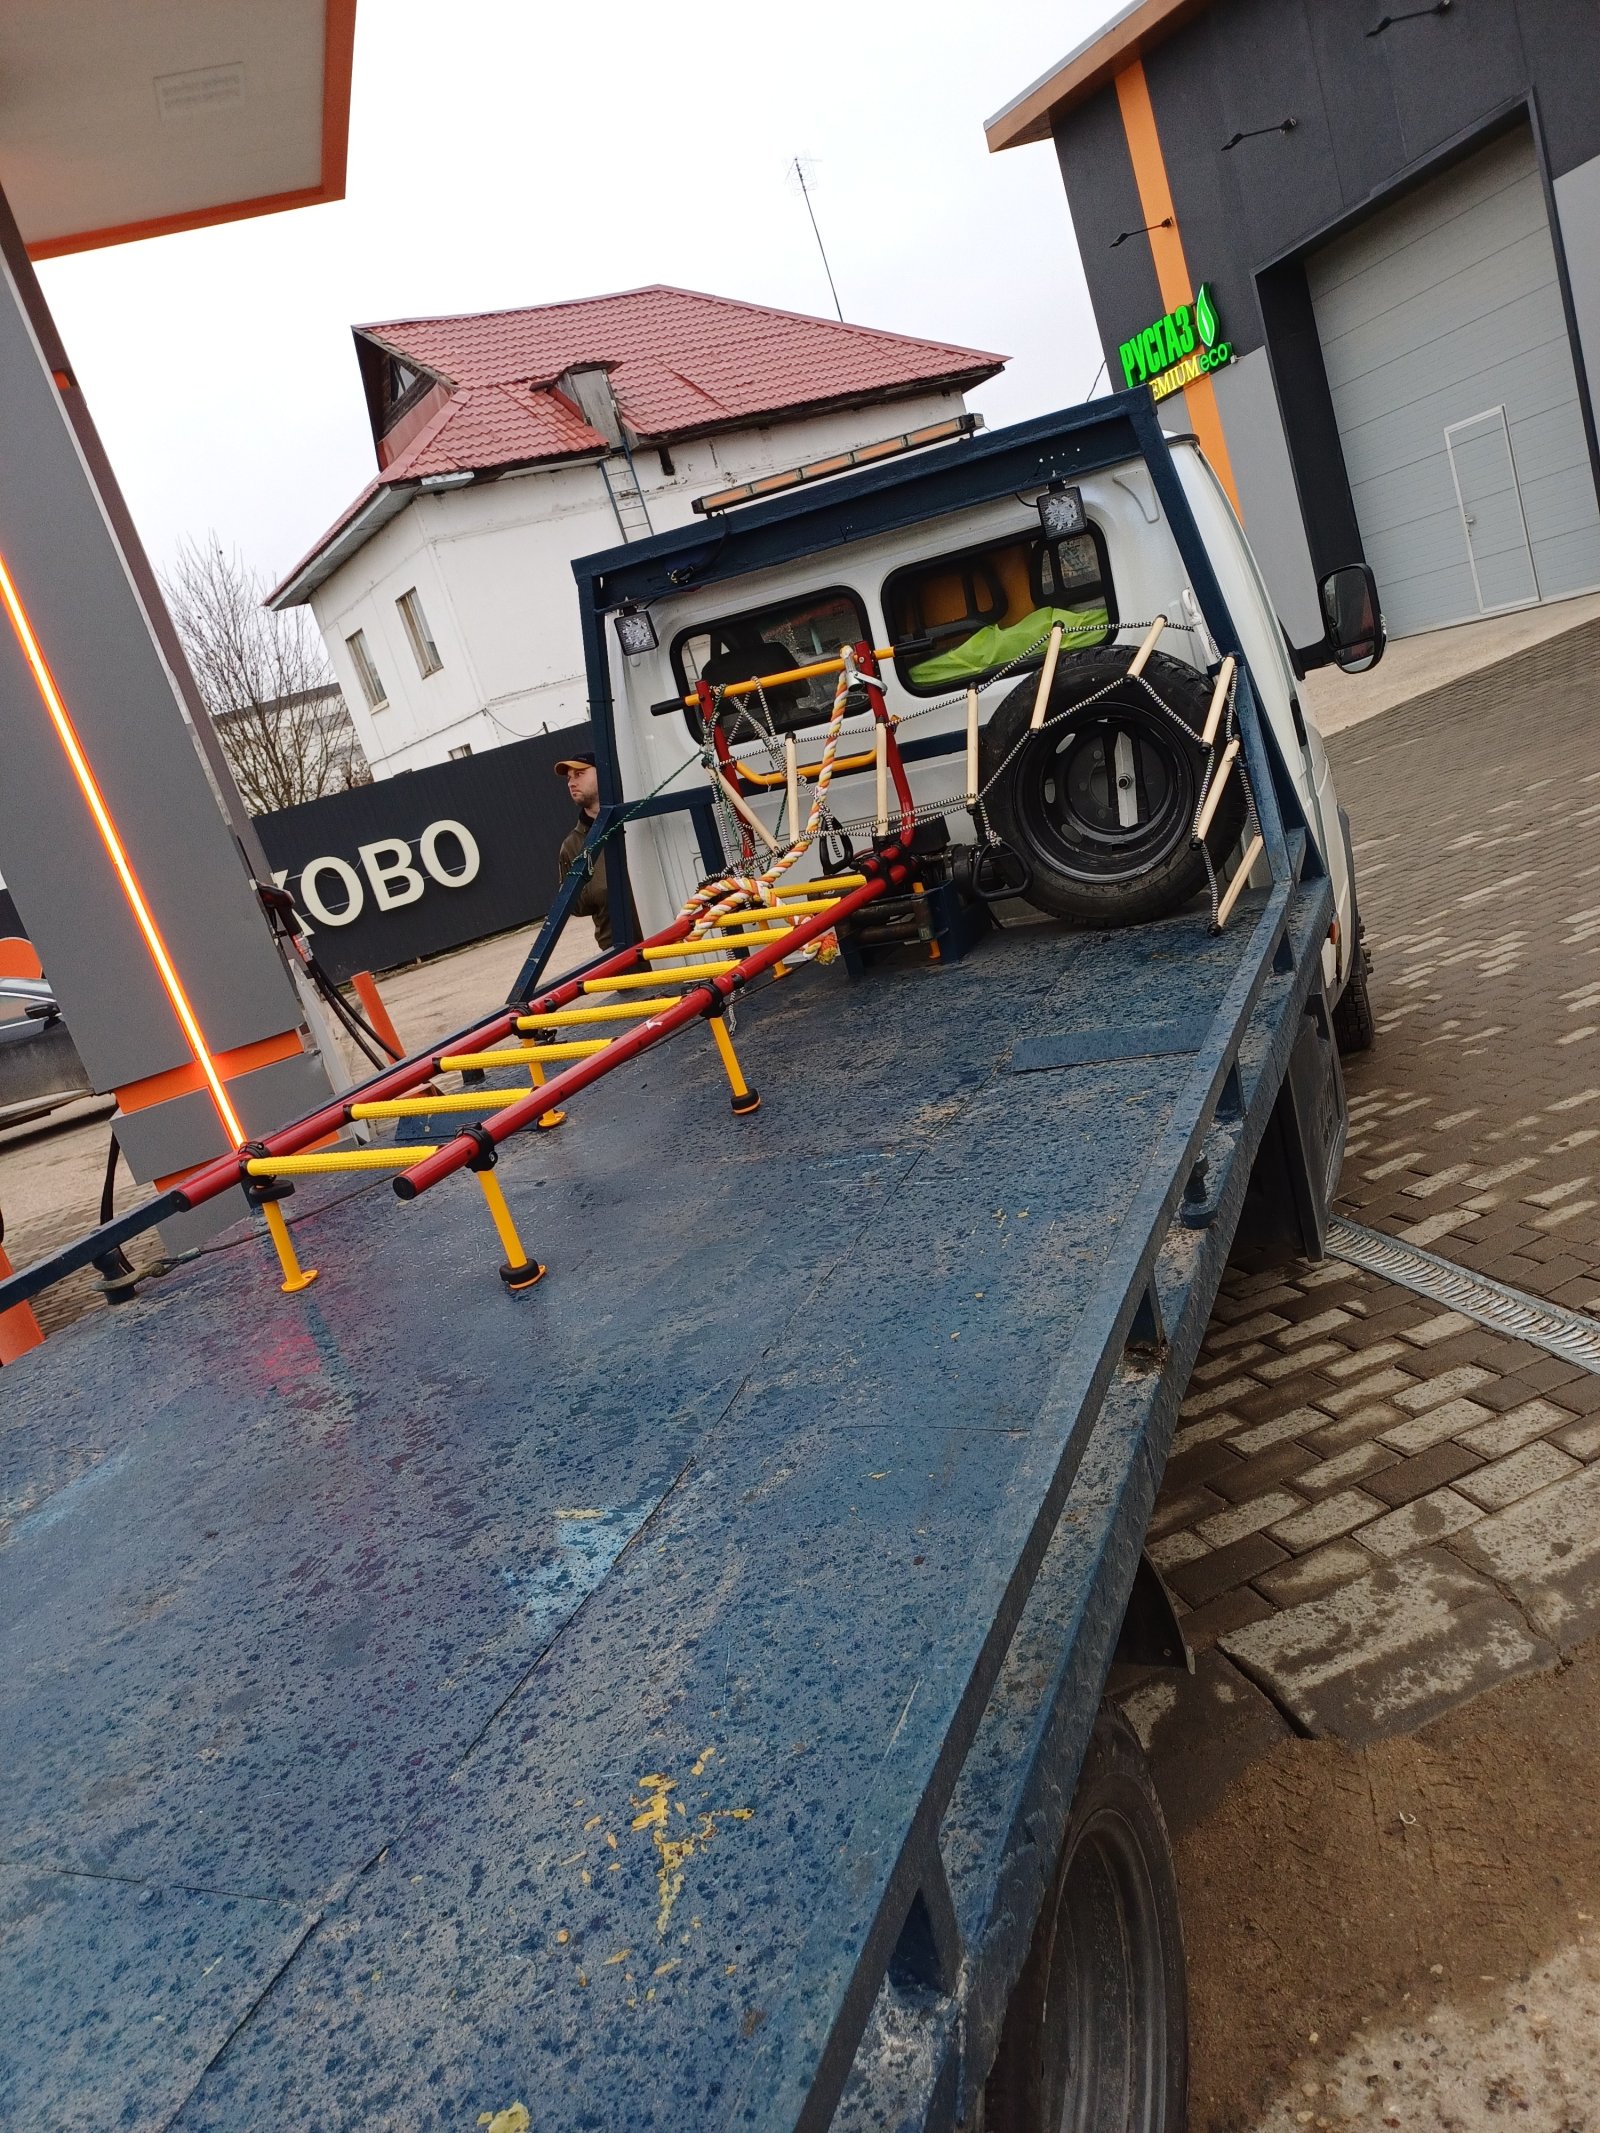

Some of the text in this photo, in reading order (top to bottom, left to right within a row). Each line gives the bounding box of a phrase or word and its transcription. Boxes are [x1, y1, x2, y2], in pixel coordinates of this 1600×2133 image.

[1119, 305, 1194, 389] РУСГАЗ
[1149, 343, 1228, 401] EMIUM eco
